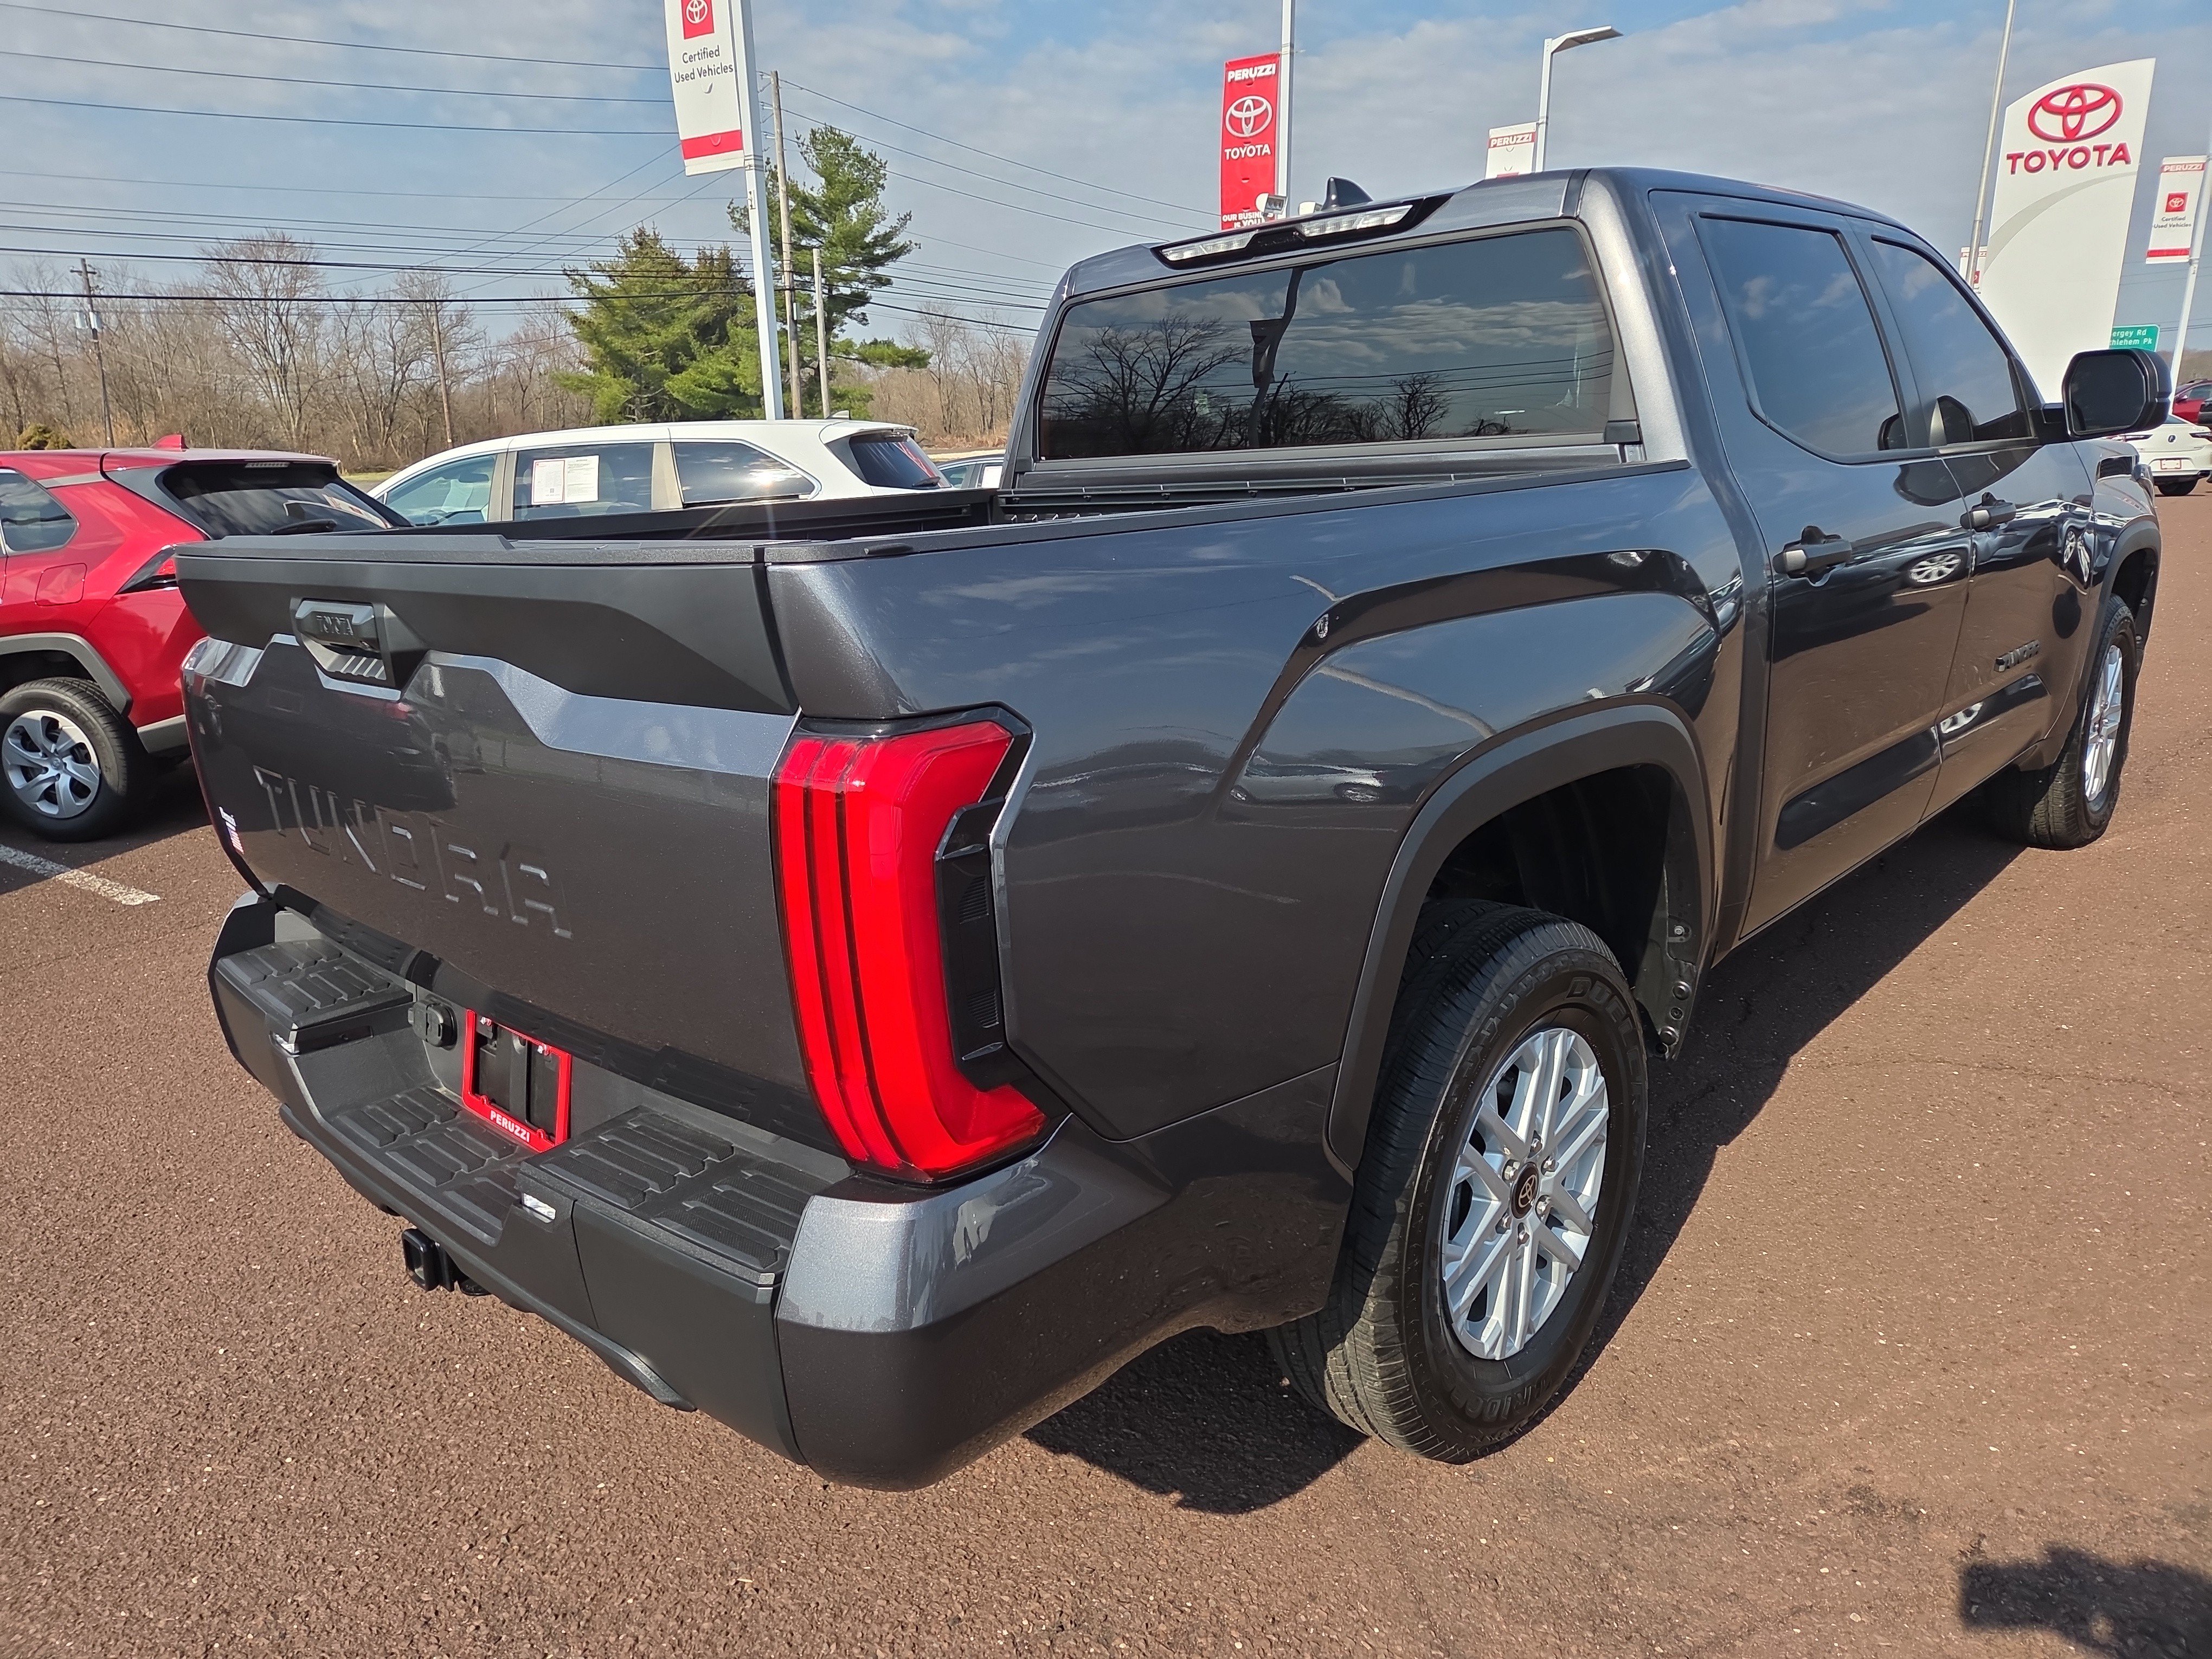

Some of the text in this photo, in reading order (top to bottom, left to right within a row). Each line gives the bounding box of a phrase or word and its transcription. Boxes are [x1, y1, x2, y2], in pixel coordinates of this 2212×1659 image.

[682, 44, 721, 64] Certified
[674, 61, 734, 83] Used Vehicles
[1227, 63, 1276, 83] PERUZZI
[1490, 133, 1533, 147] PERUZZI
[1224, 144, 1271, 160] TOYOTA
[2007, 142, 2132, 175] TOYOTA
[2163, 163, 2203, 172] PERUZZI
[1222, 214, 1238, 222] OUR
[2112, 330, 2134, 338] ergey
[253, 765, 573, 940] TUNDRA
[490, 1110, 531, 1143] PERUZZI
